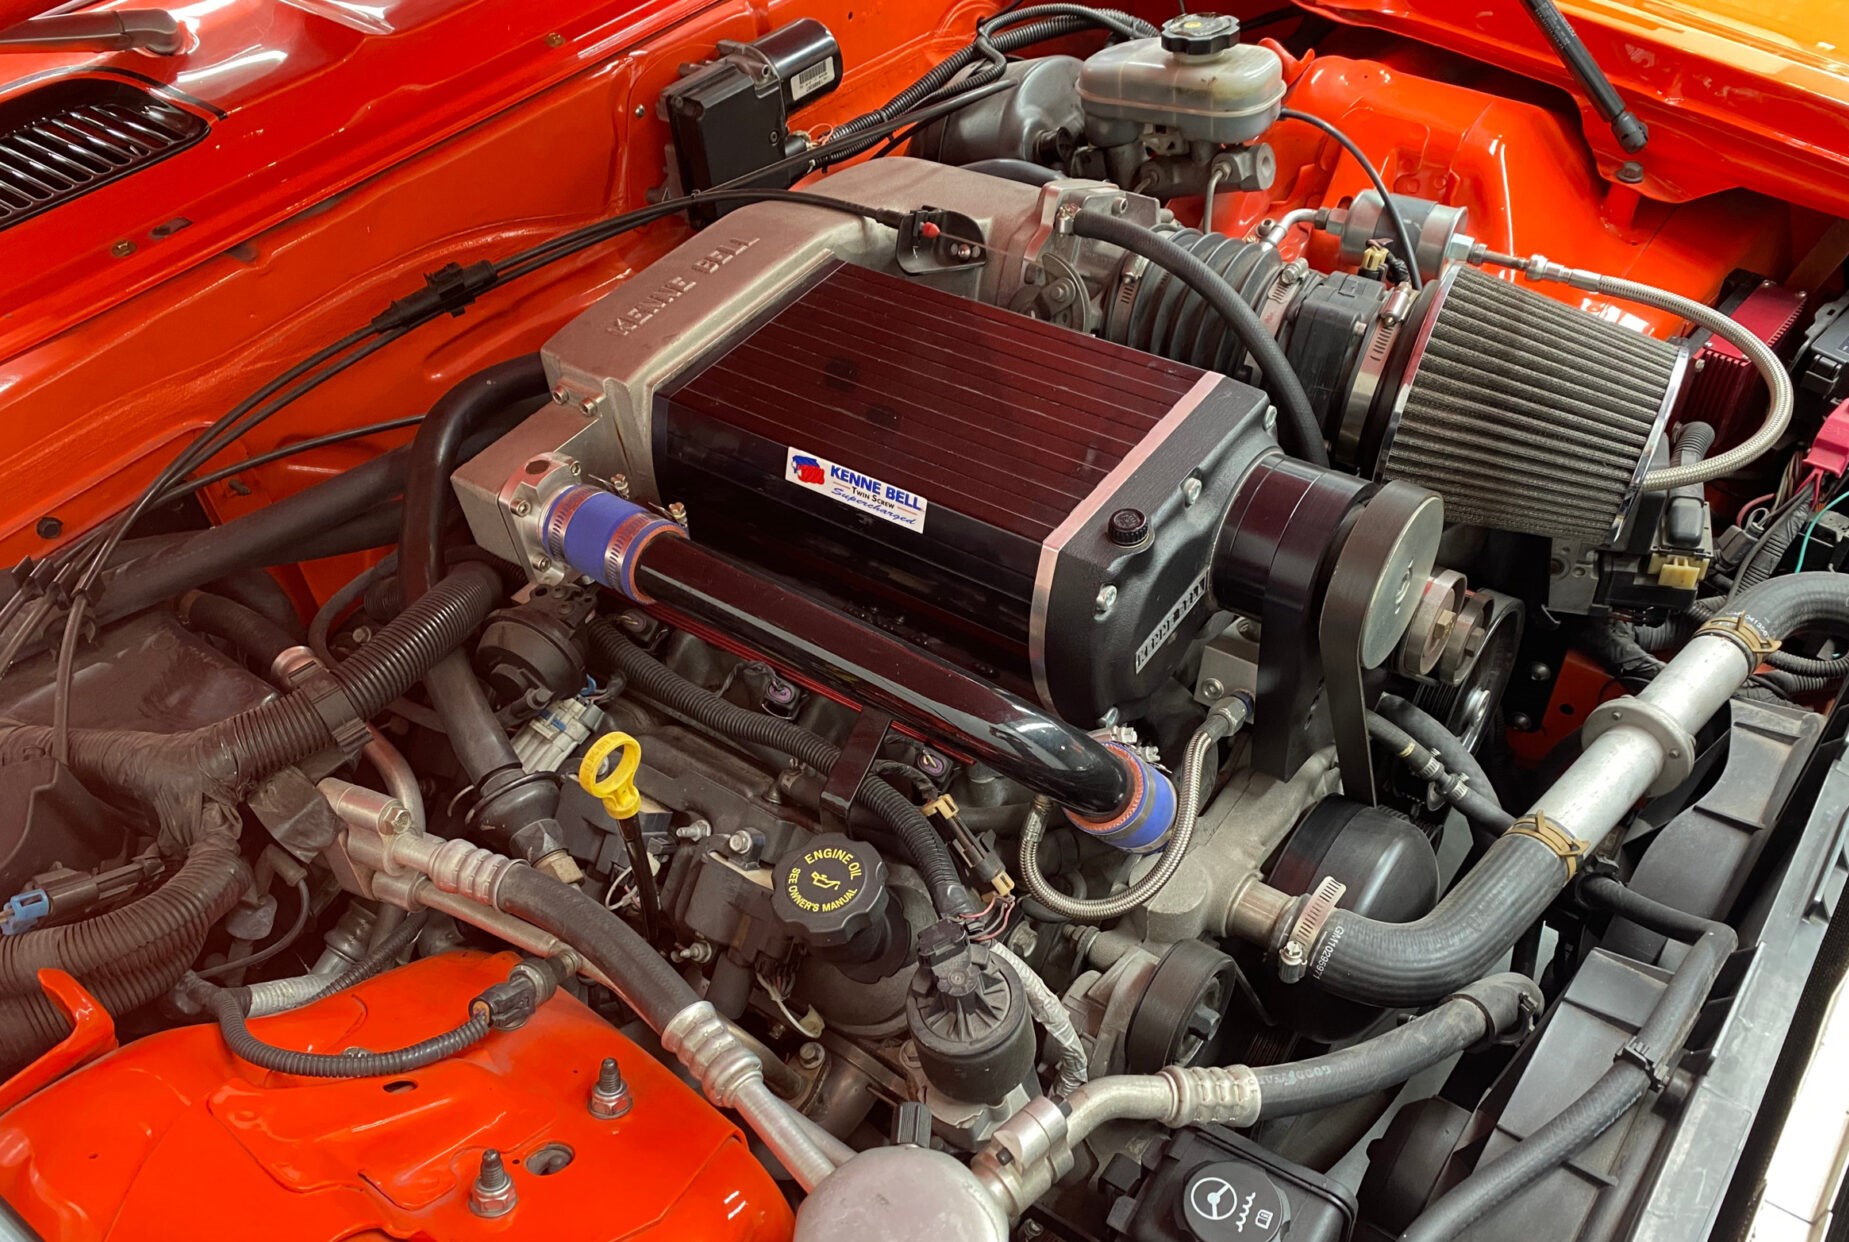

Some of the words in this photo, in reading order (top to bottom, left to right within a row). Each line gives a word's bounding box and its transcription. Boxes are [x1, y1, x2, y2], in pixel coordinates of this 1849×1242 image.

[606, 276, 697, 336] KENNE
[691, 237, 761, 274] BELL
[830, 464, 882, 495] KENNE
[885, 485, 922, 511] BELL
[831, 487, 917, 525] Supercharged
[788, 867, 801, 885] SEE
[804, 848, 854, 865] ENGINE
[848, 861, 863, 881] OIL
[788, 885, 820, 913] OWNER'S
[822, 888, 858, 912] MANUAL
